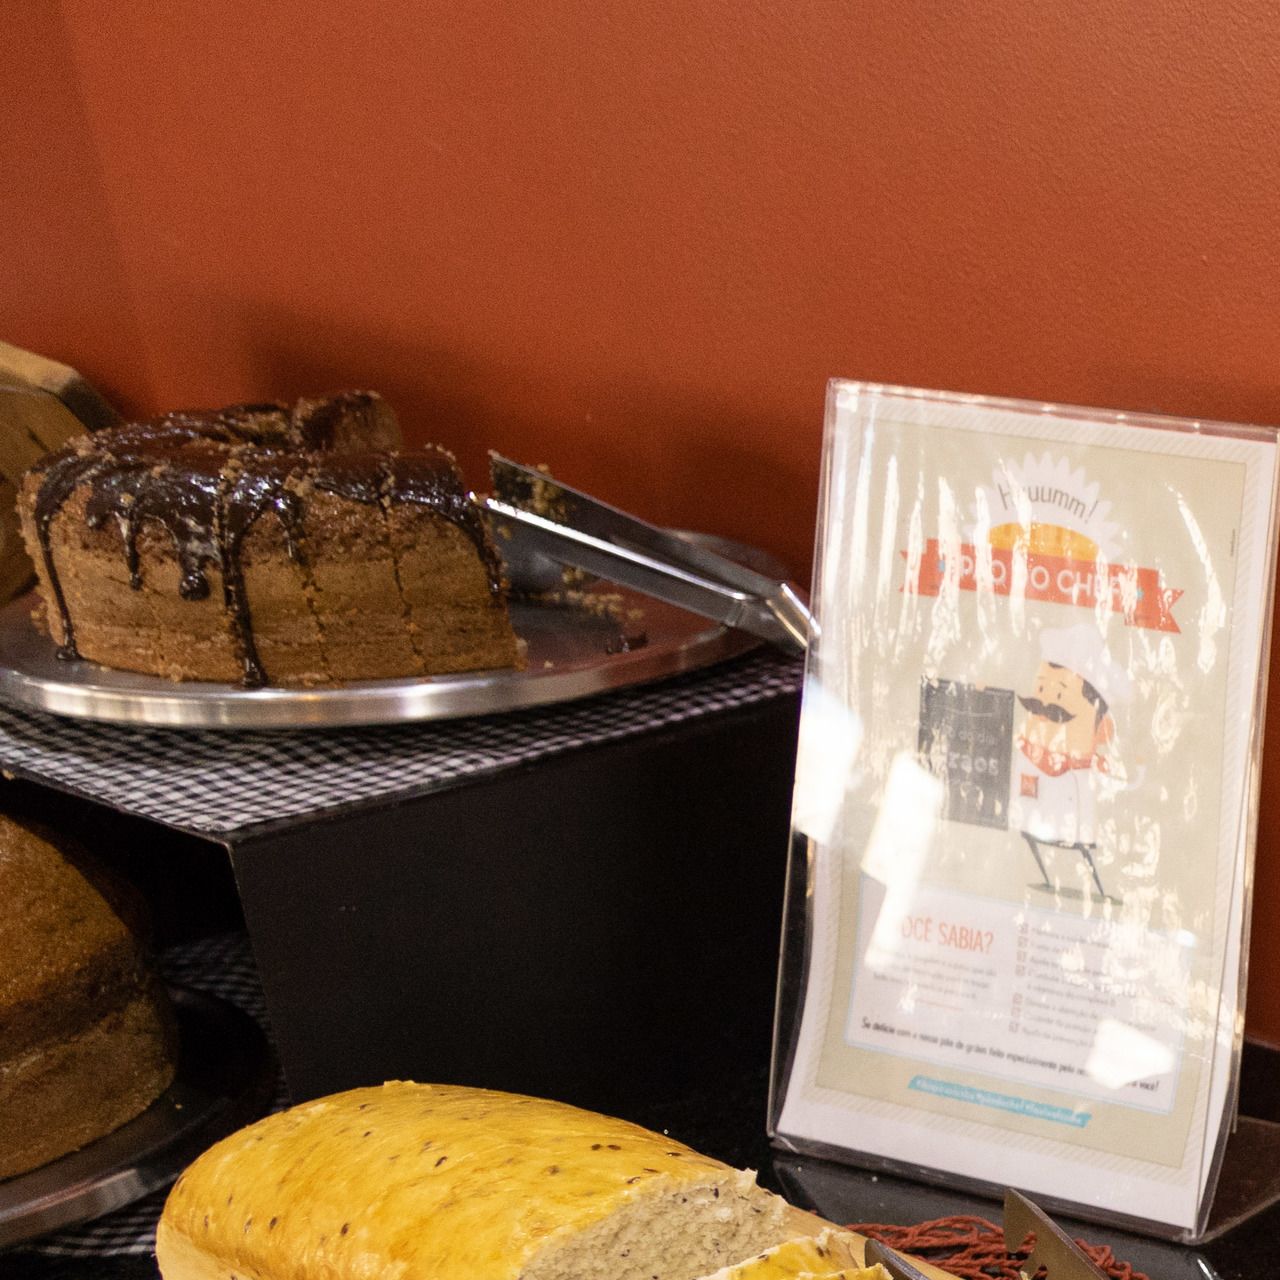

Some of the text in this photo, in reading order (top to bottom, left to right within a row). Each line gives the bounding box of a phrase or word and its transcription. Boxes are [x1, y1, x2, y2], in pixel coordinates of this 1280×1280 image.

[997, 483, 1098, 524] Huumm!
[900, 914, 934, 943] OCÊ
[938, 921, 995, 955] SABIA?
